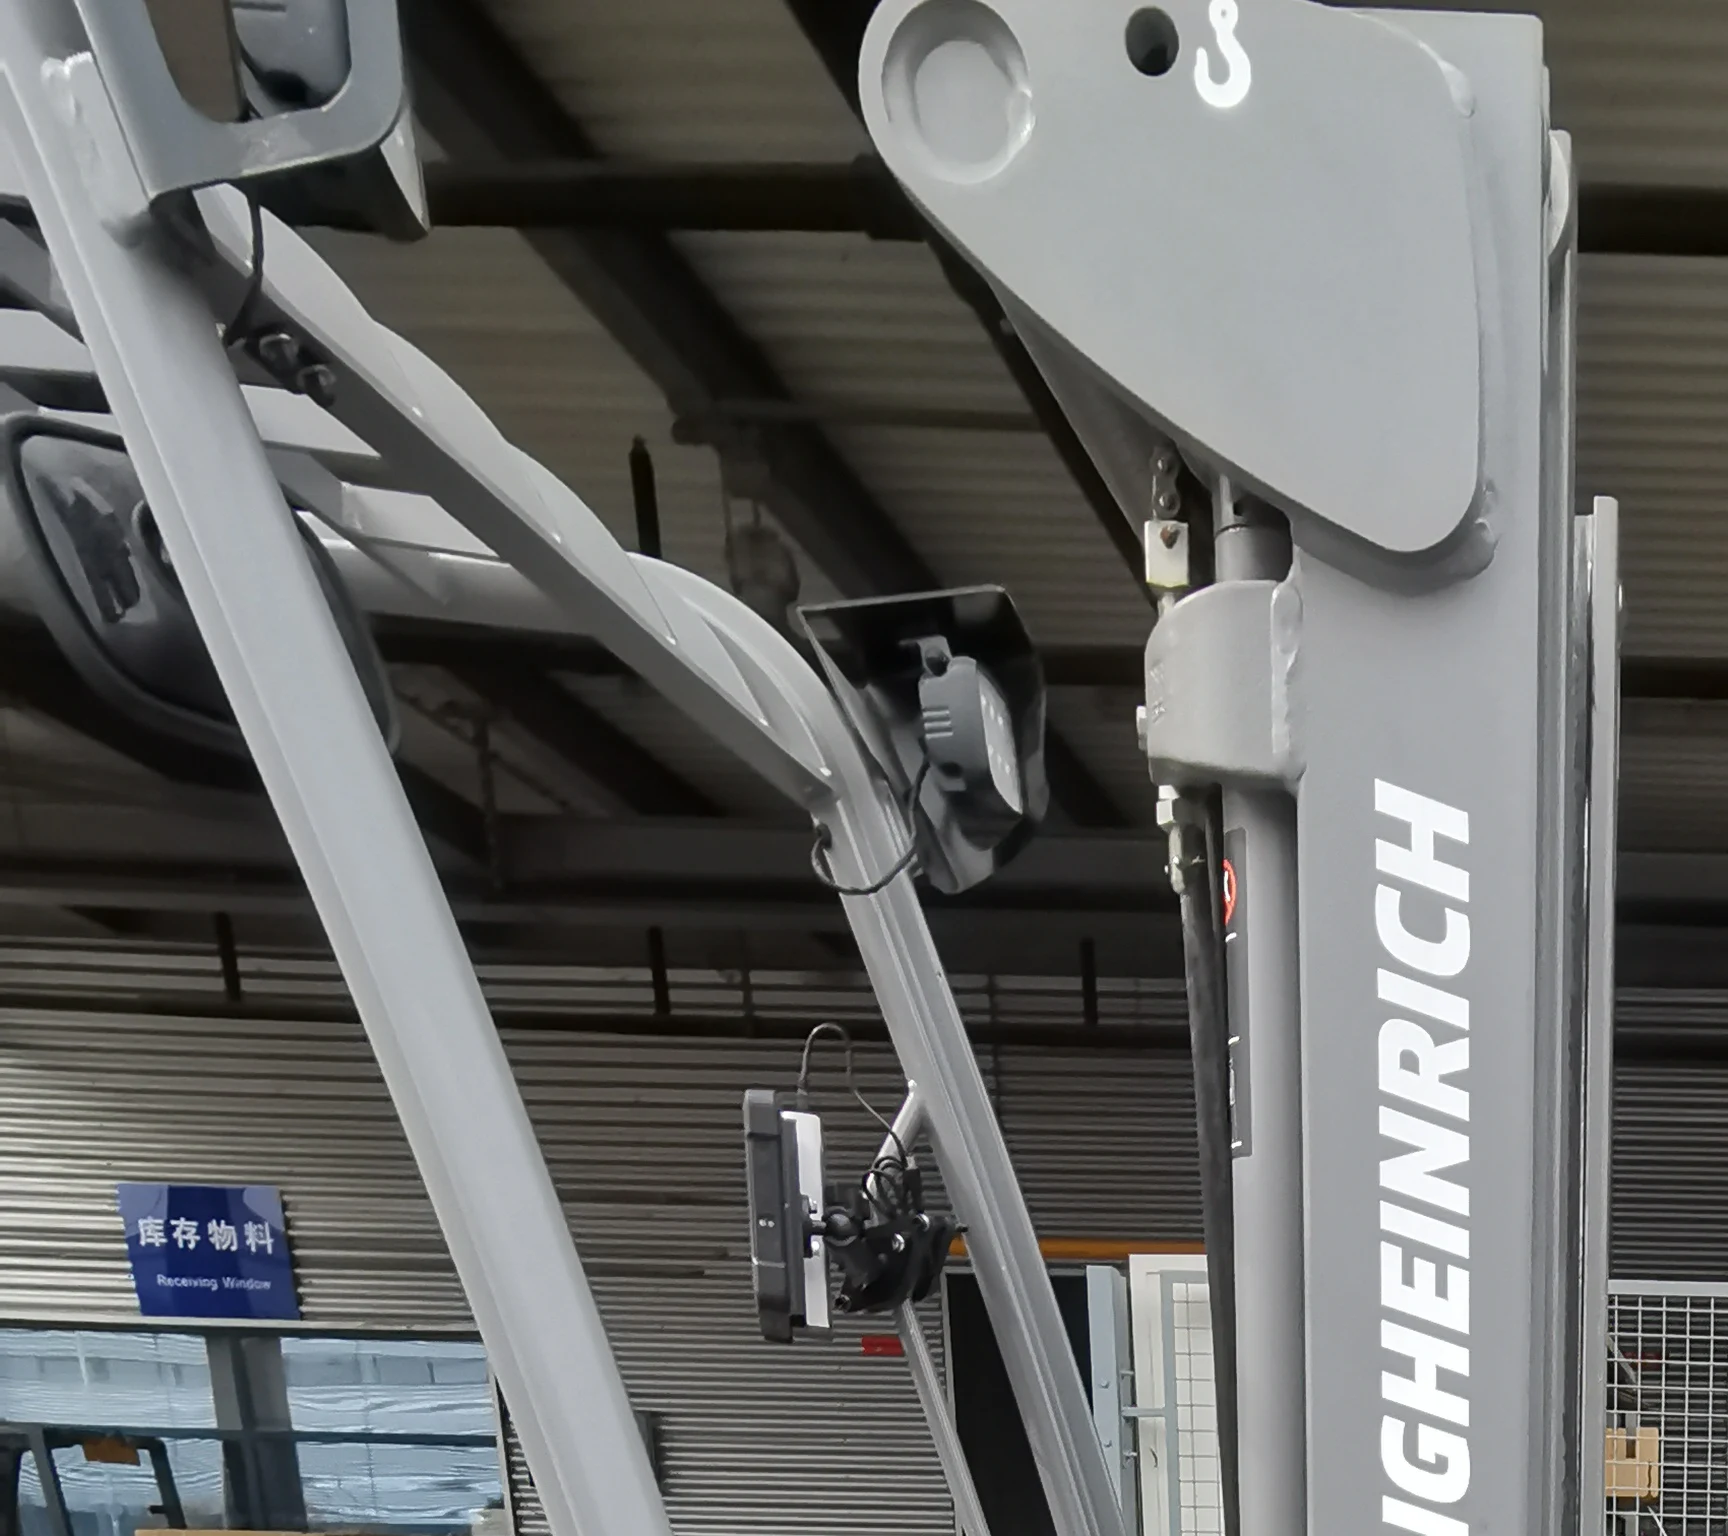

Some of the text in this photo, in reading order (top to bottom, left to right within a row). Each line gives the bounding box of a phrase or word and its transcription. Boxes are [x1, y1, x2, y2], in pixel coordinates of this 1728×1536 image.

[138, 1216, 274, 1254] 库存物料
[157, 1273, 271, 1291] Receiving Window
